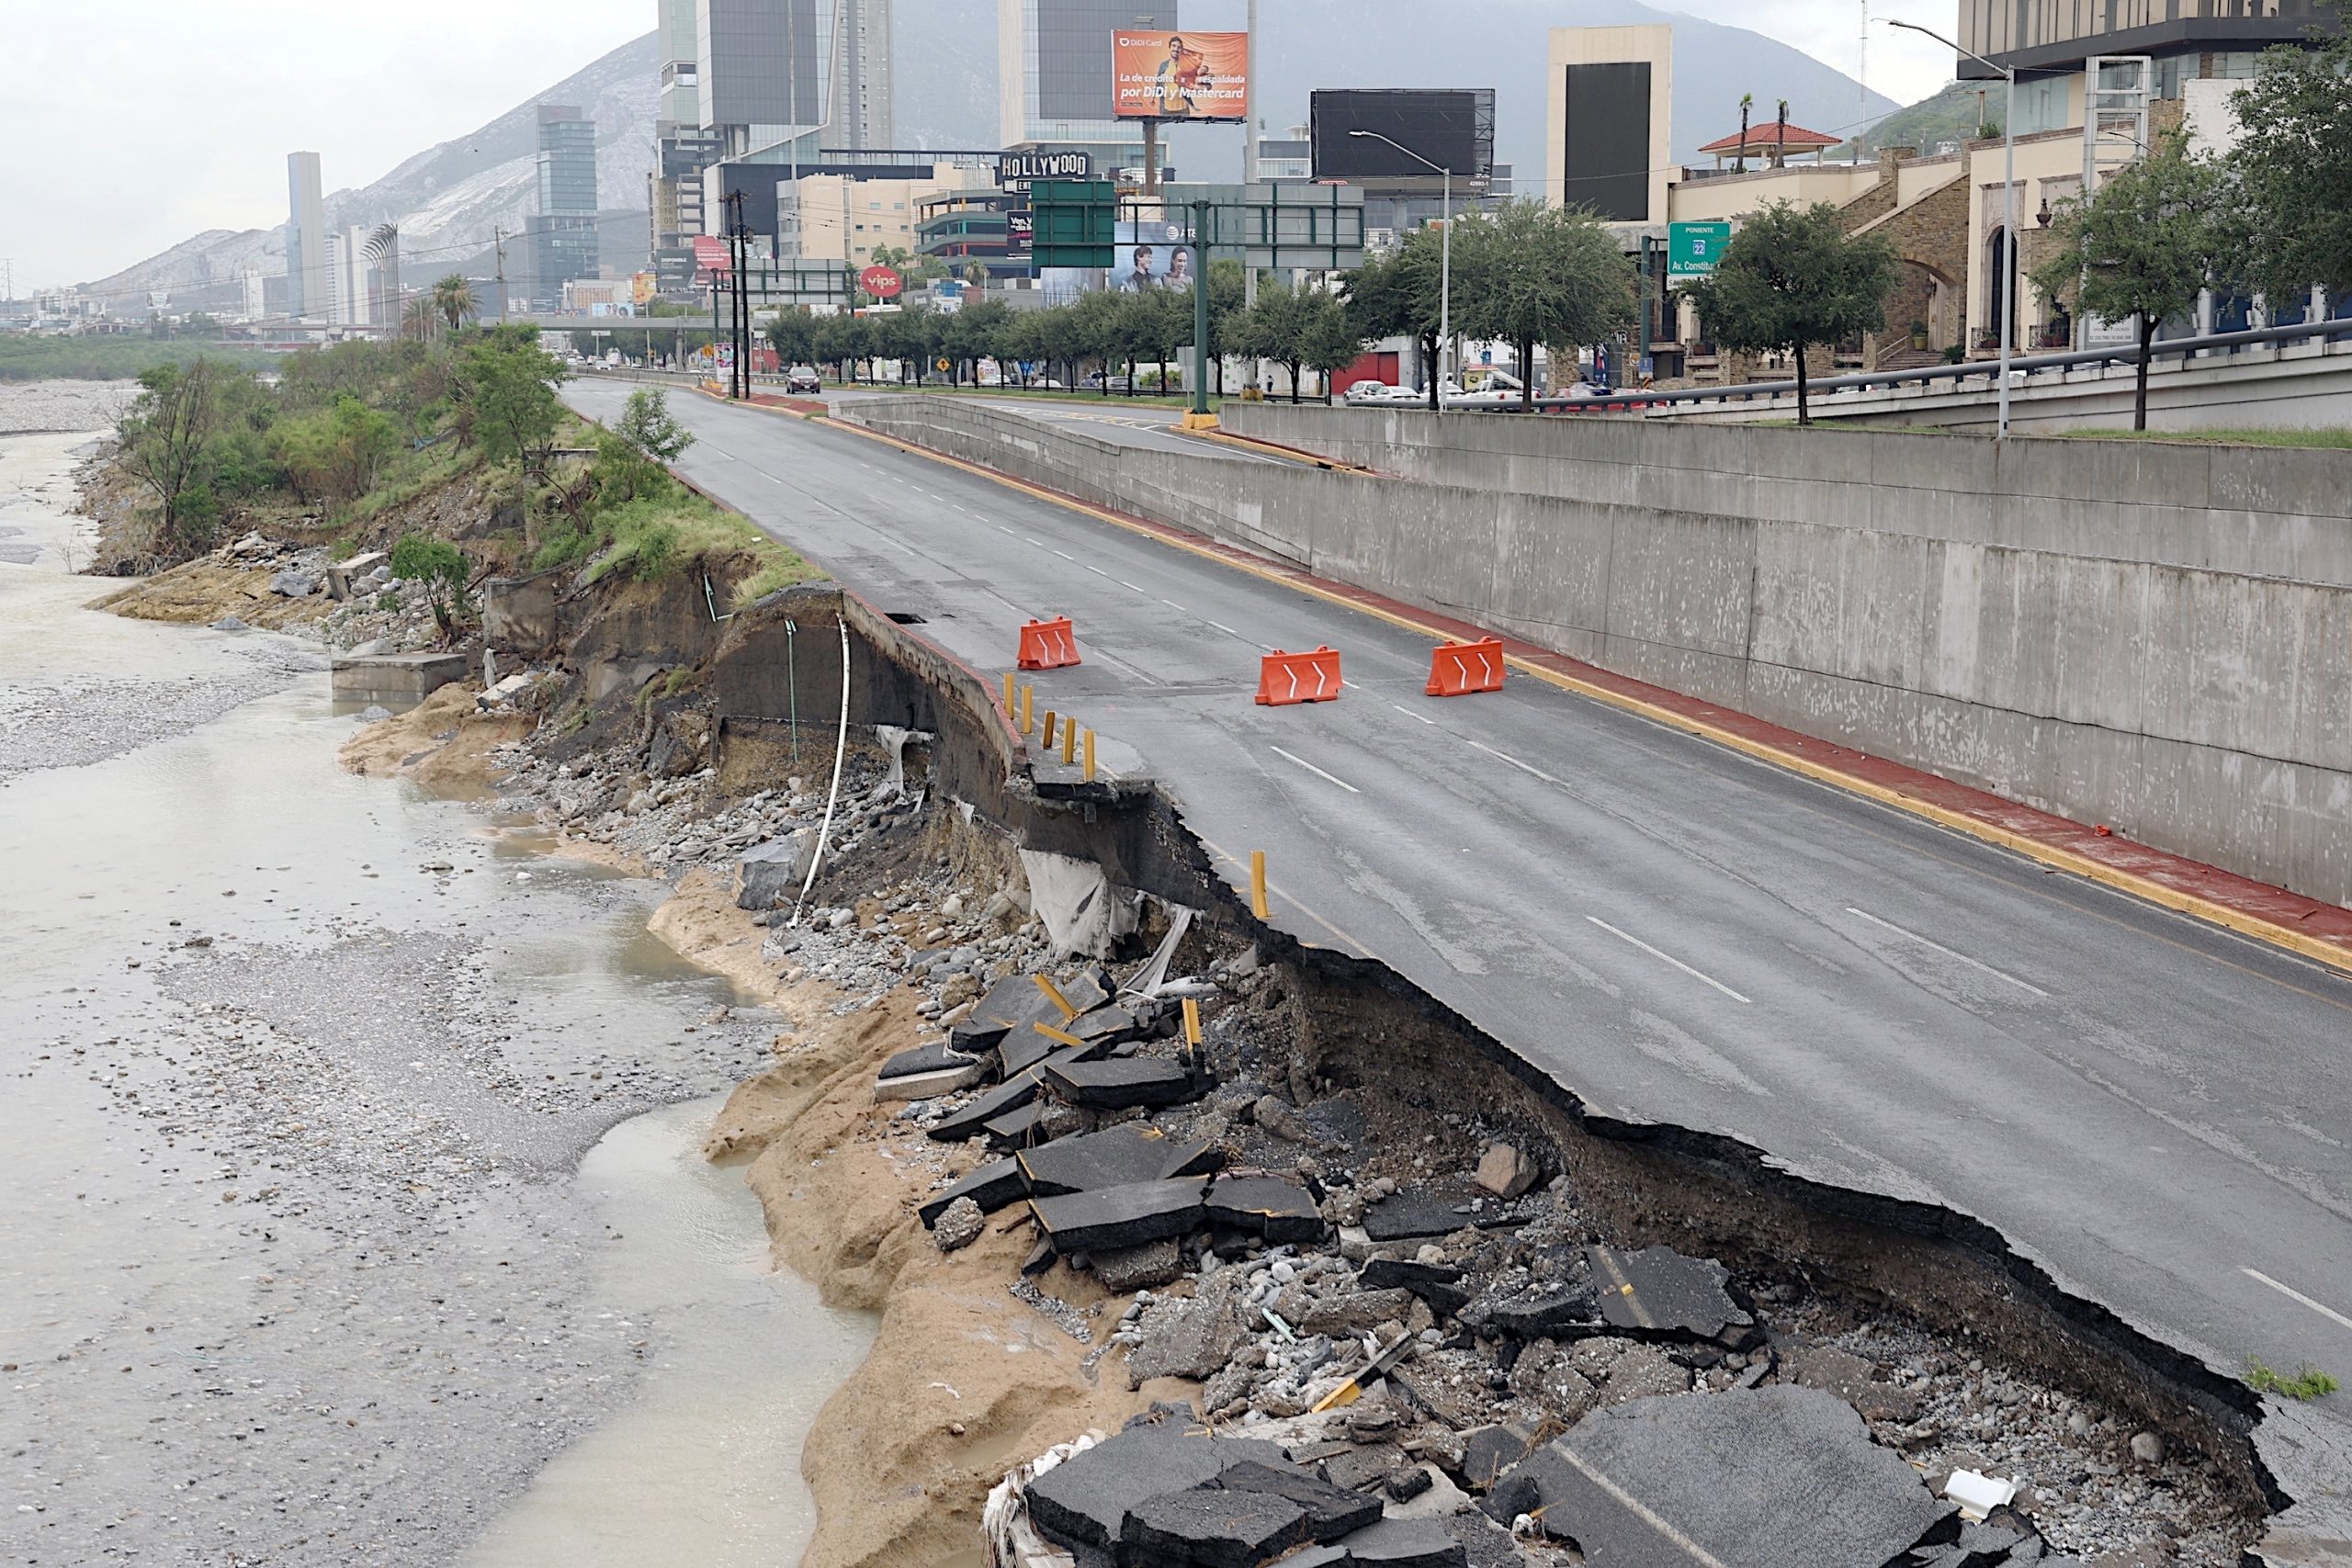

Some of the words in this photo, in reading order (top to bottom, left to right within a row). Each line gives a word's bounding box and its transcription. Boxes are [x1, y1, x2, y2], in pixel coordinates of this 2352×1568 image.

[1120, 73, 1130, 82] La
[1132, 73, 1143, 82] de
[1144, 73, 1174, 83] crédito
[1121, 88, 1141, 99] por
[1143, 86, 1168, 97] DiDi
[1169, 89, 1177, 100] y
[1179, 87, 1244, 98] Mastercard
[1002, 154, 1086, 176] HOLLYWOOD
[1180, 228, 1196, 238] AT&
[1694, 244, 1704, 254] 22
[1672, 261, 1683, 270] Av.
[1684, 261, 1714, 271] Constitu
[867, 274, 897, 289] vips
